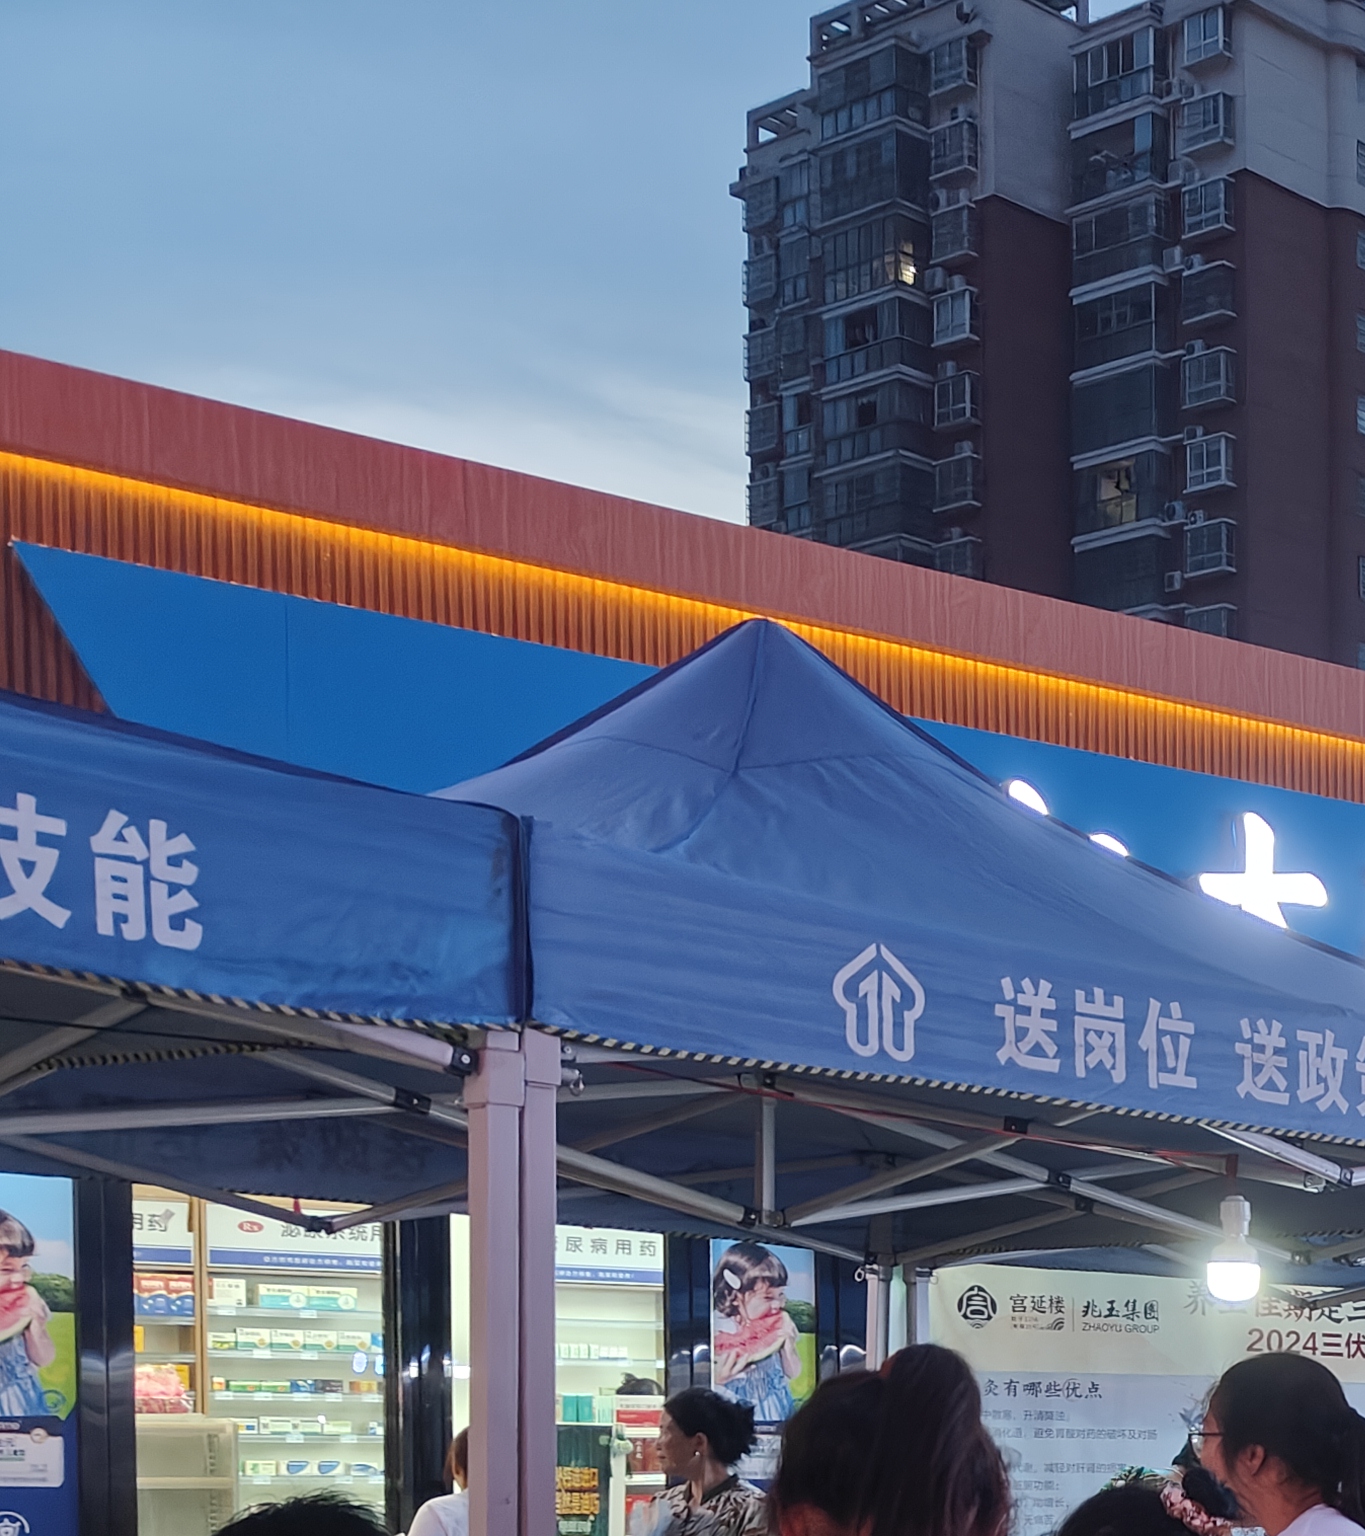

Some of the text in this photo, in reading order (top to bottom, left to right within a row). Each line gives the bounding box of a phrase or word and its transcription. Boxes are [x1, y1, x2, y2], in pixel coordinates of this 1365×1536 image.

[994, 976, 1199, 1090] 送岗位
[556, 1236, 657, 1257] 尿病用药
[1081, 1322, 1160, 1334] ZHAOYU GROUP
